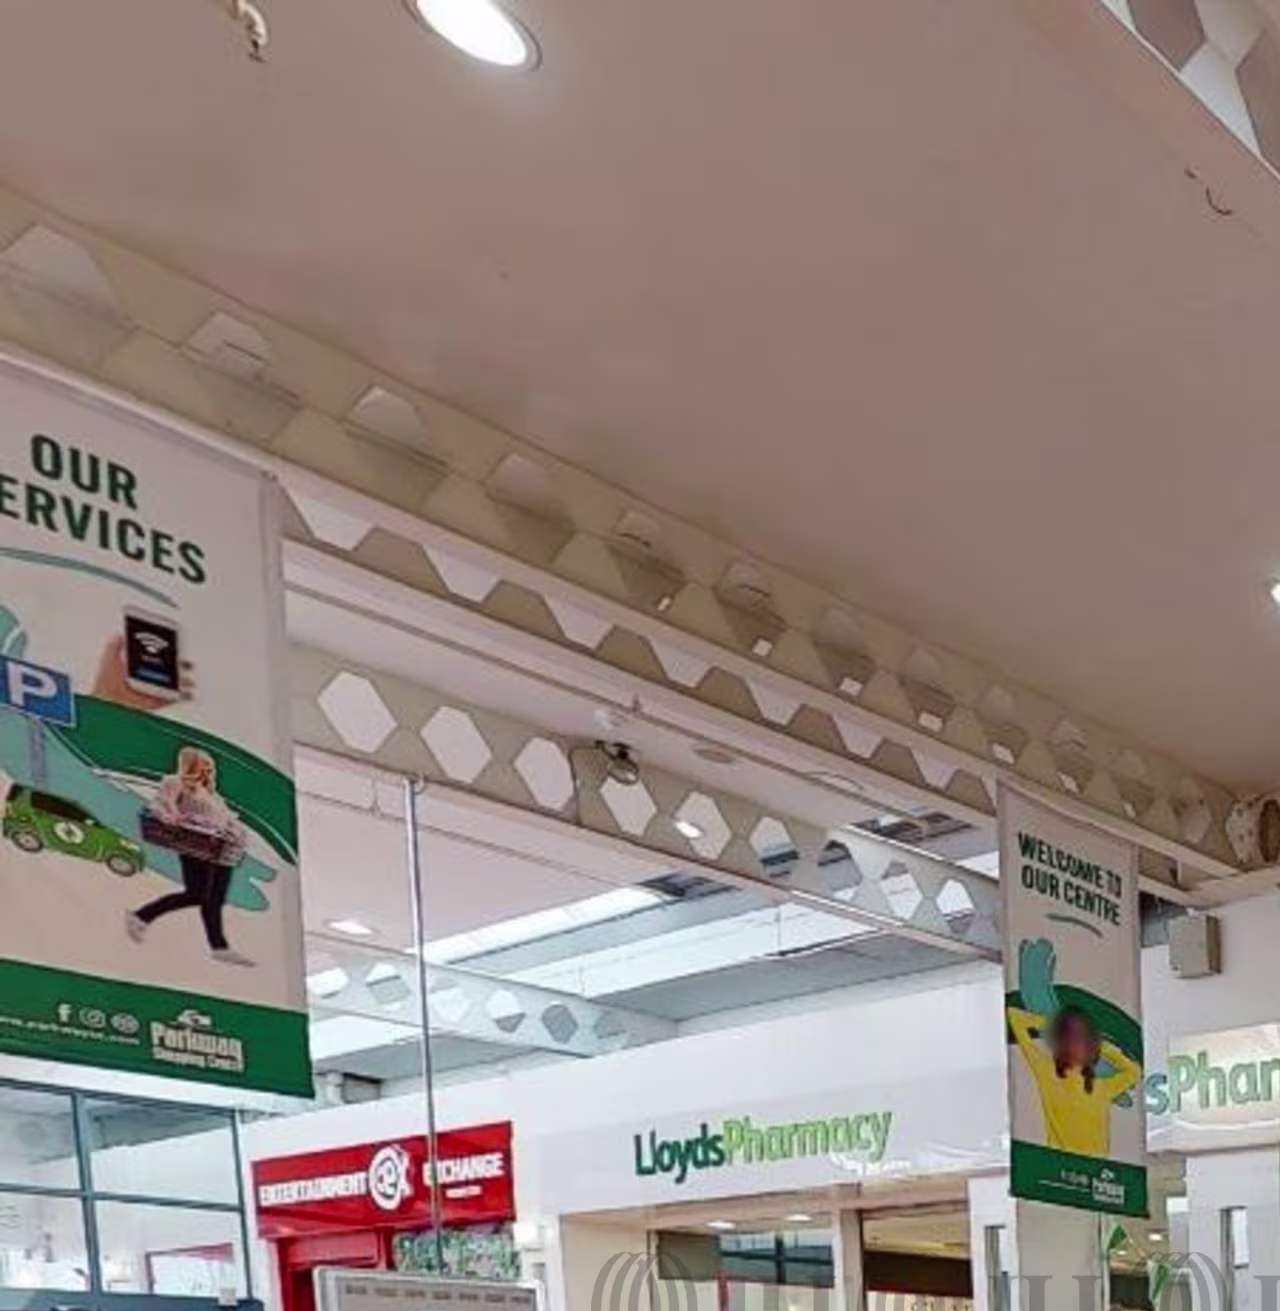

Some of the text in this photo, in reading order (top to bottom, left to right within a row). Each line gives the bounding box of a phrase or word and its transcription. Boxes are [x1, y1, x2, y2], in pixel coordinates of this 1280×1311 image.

[31, 433, 138, 511] OUR
[0, 473, 207, 585] ERVICES
[6, 661, 58, 707] P
[1018, 830, 1122, 899] WELCOME TO
[1021, 864, 1121, 927] OUR CENTRE
[634, 1112, 892, 1184] LloydsPharmacy
